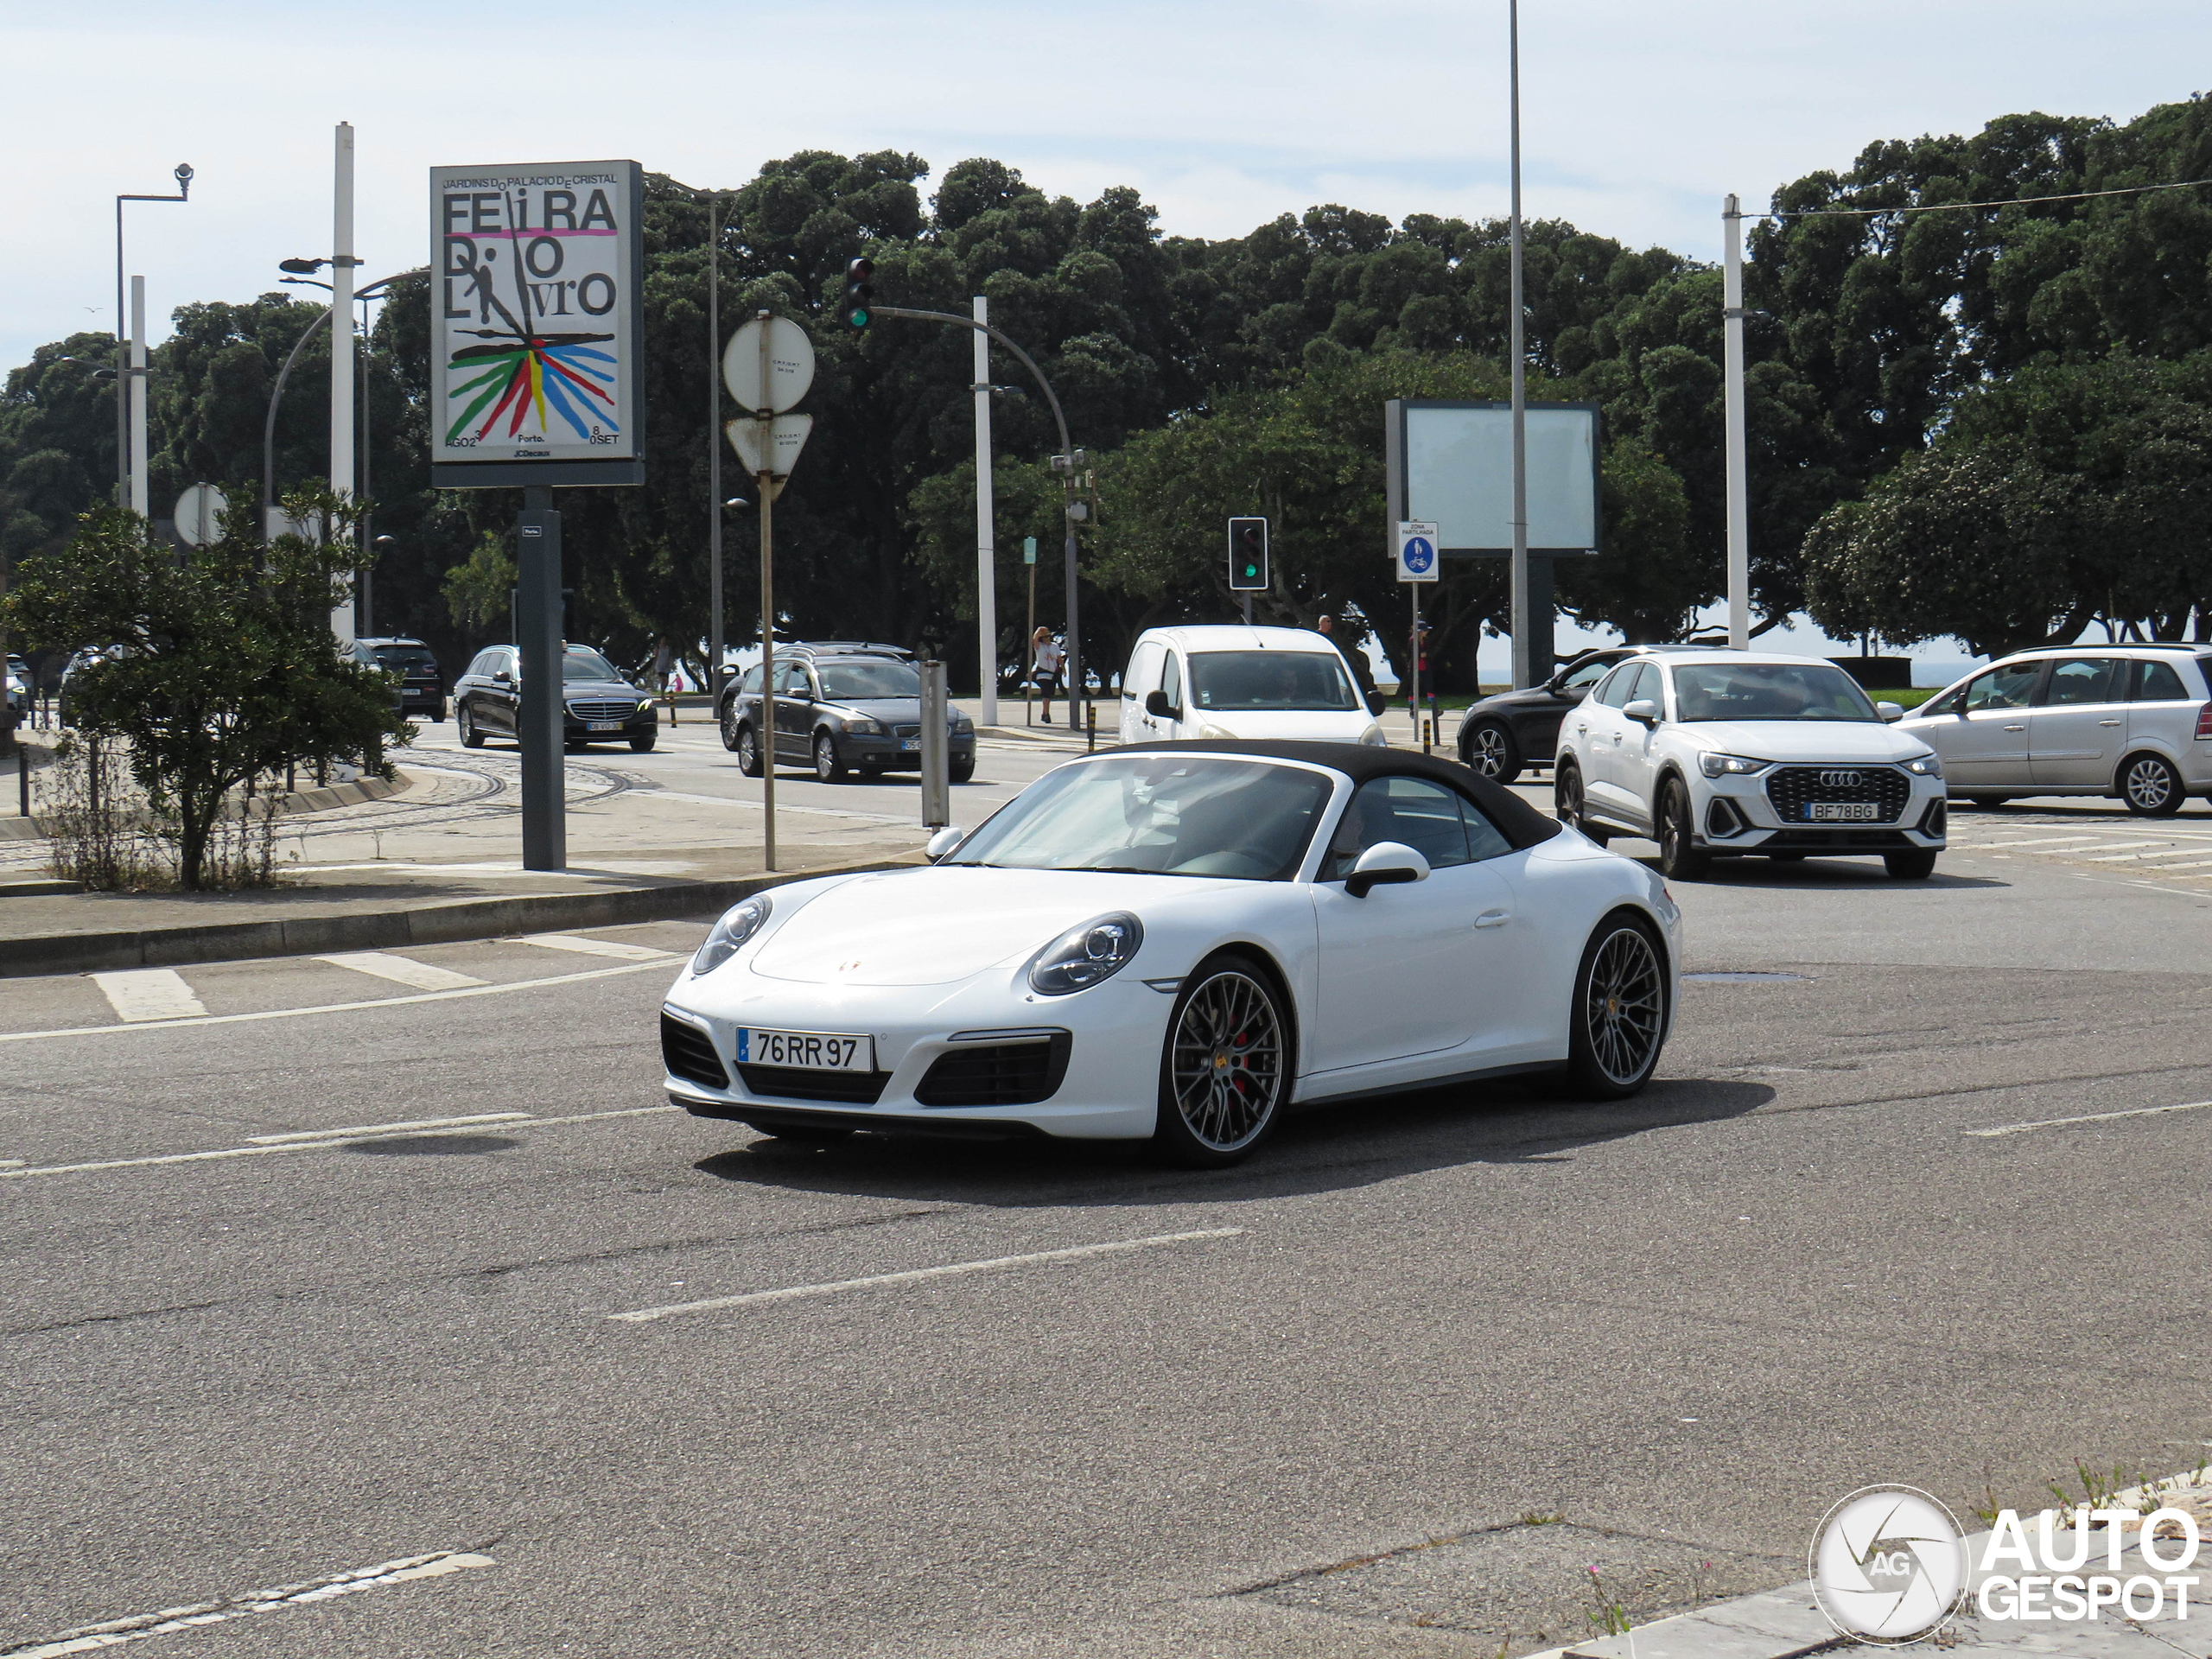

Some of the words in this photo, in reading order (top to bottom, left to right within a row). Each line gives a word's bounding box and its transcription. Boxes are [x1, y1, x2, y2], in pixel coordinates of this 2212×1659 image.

[443, 179, 489, 189] JARDINS
[572, 175, 618, 185] CRISTAL
[513, 449, 551, 458] JCDecaux
